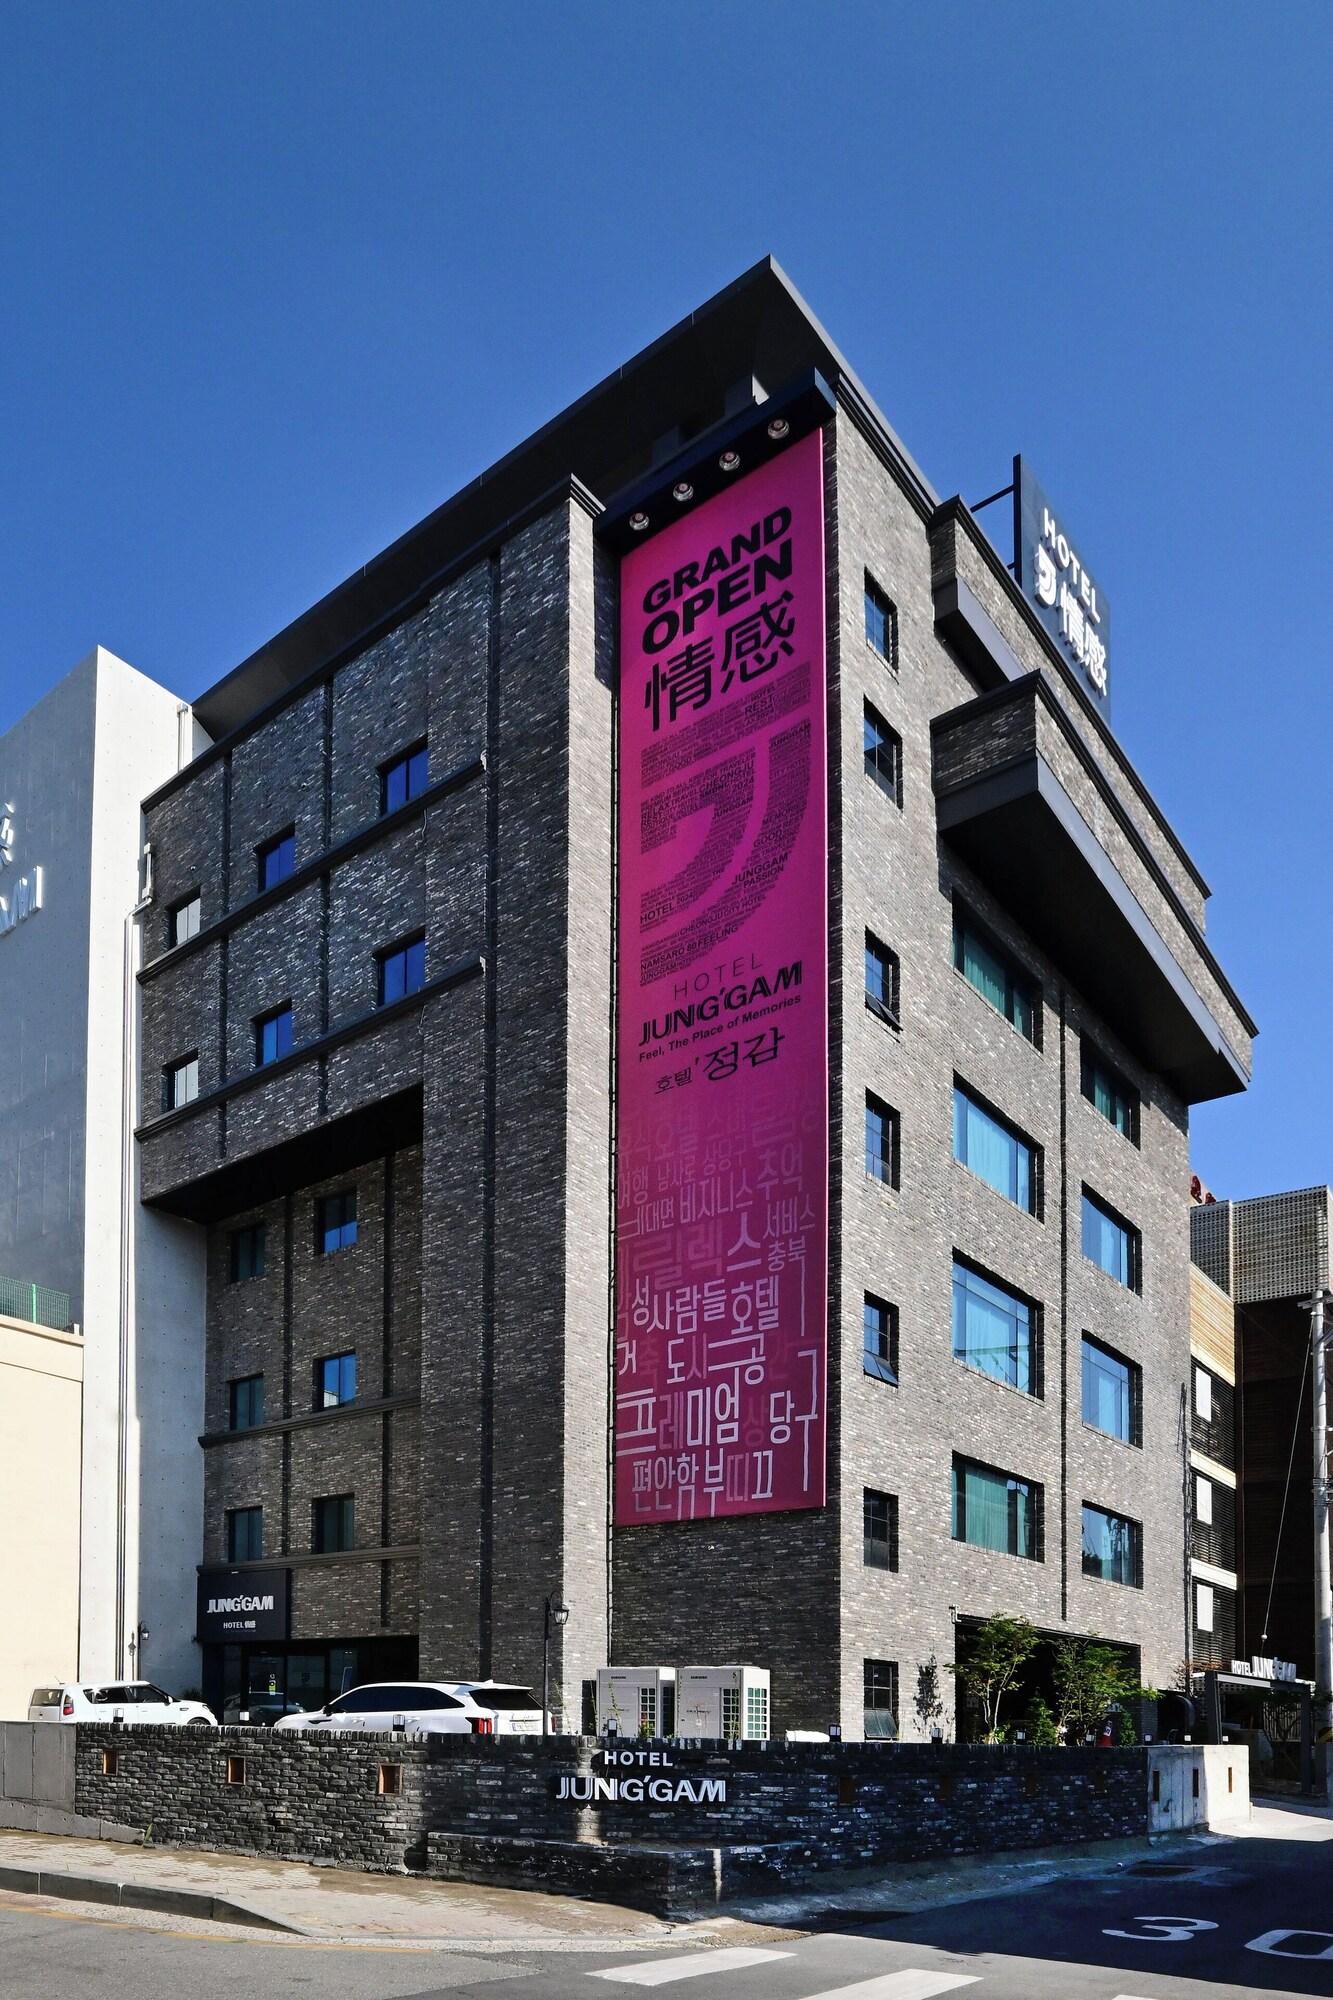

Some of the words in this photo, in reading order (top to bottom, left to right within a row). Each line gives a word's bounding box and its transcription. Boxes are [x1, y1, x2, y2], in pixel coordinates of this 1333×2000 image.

[643, 507, 792, 613] GRAND
[1043, 507, 1101, 624] HOTEL
[643, 538, 792, 654] OPEN
[645, 590, 795, 731] 情感
[745, 693, 773, 715] REST
[699, 760, 753, 793] CHEONGJU
[732, 774, 754, 793] 2024
[711, 794, 753, 820] JUNGGAM
[731, 851, 788, 885] JUNGGAM
[743, 863, 784, 888] PASSION
[640, 900, 674, 924] HOTEL
[640, 946, 684, 972] NAMSARO
[698, 924, 738, 947] FEELING
[674, 953, 762, 1000] HOTEL
[639, 960, 803, 1046] JUNG'GAM
[639, 1046, 665, 1062] Feel,
[669, 1036, 689, 1051] The
[692, 1025, 724, 1042] Place
[727, 1017, 739, 1030] of
[742, 995, 801, 1024] Memories
[655, 1067, 692, 1094] 호텔
[679, 1168, 753, 1225] 비지니스
[763, 1194, 816, 1240] 서비스
[647, 1278, 728, 1335] 사람들
[731, 1274, 781, 1336] 호텔
[207, 1595, 274, 1613] JUNG'GAM
[223, 1621, 245, 1629] HOTEL
[1231, 1659, 1252, 1677] HOTEL
[604, 1750, 674, 1767] HOTEL
[556, 1775, 726, 1802] JUNG'GAM
